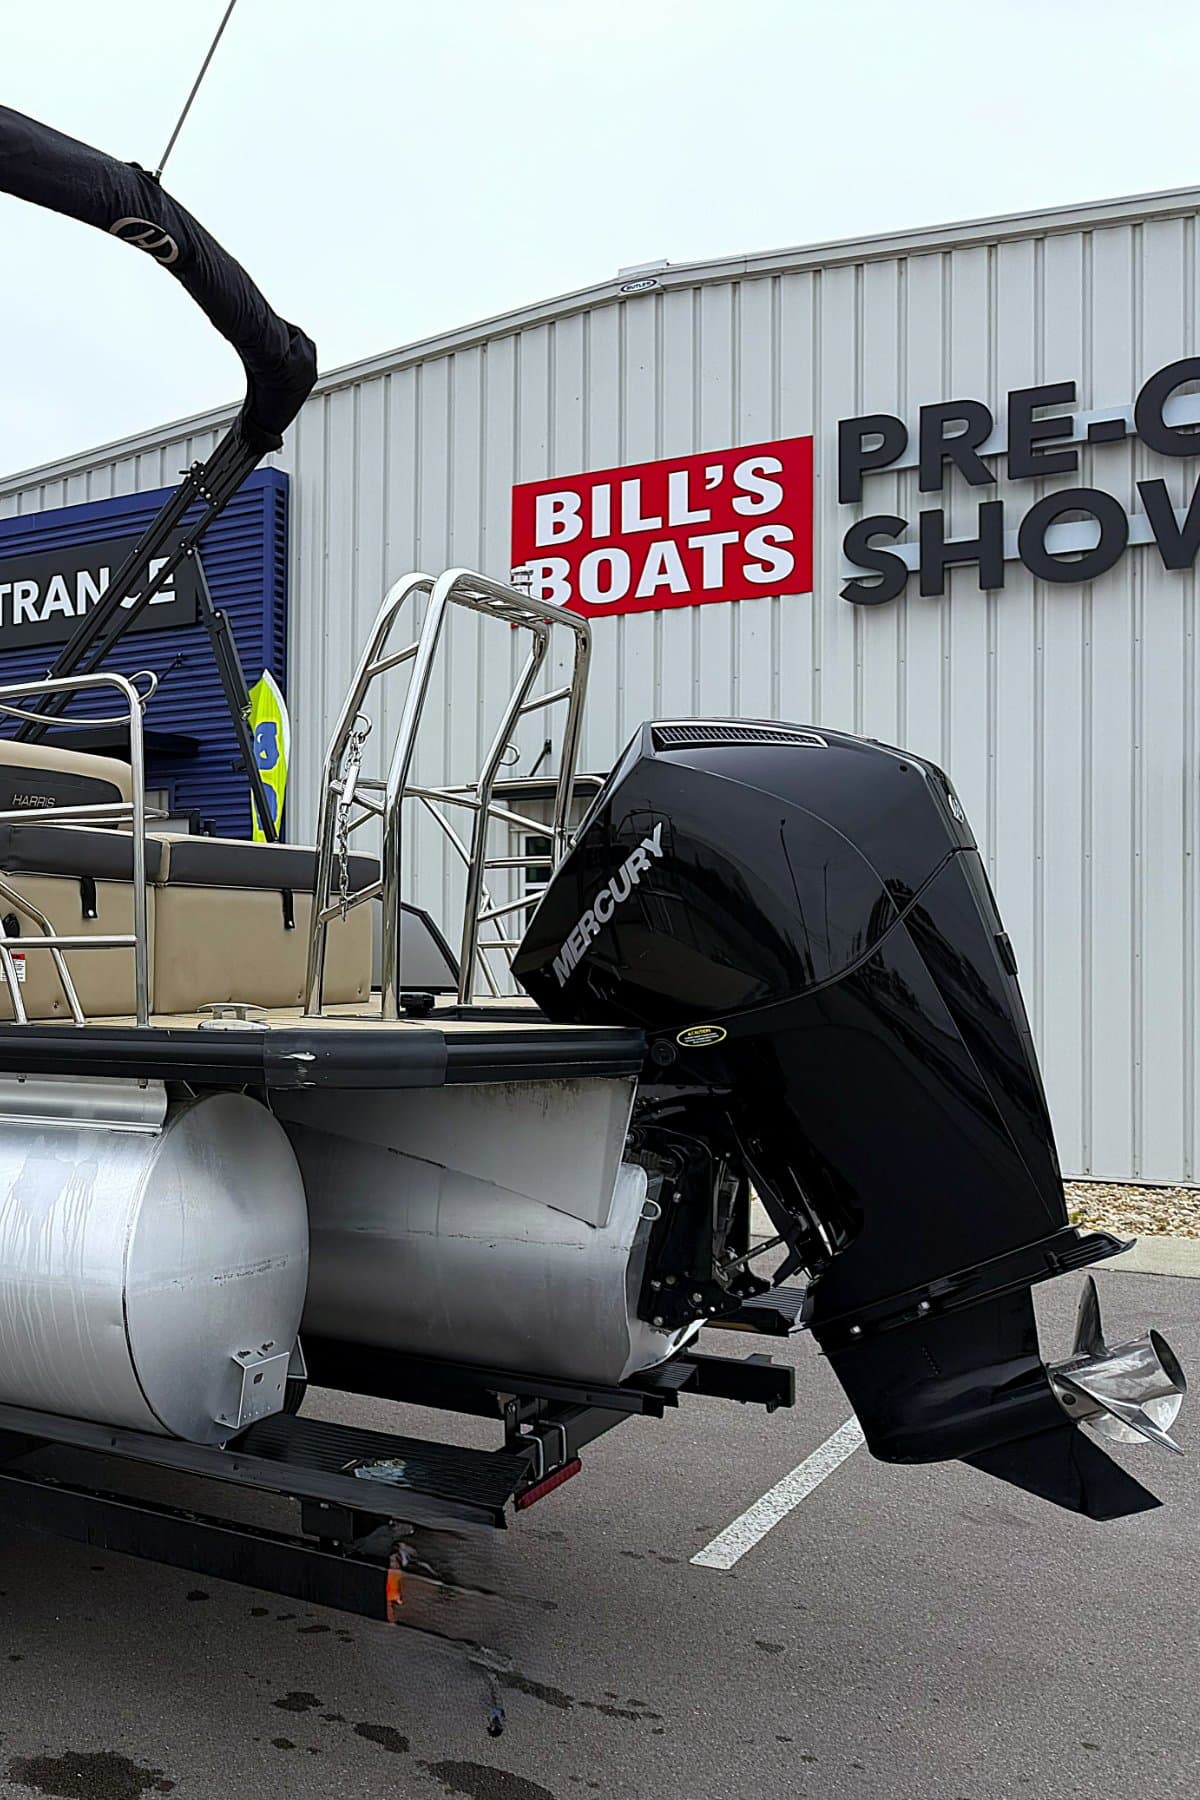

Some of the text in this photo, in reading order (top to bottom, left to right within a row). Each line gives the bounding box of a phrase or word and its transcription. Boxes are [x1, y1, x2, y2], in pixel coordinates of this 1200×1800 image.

[534, 455, 785, 548] BILL'S
[524, 524, 795, 609] BOATS
[12, 794, 56, 808] HARRIS
[552, 821, 664, 989] MERCURY
